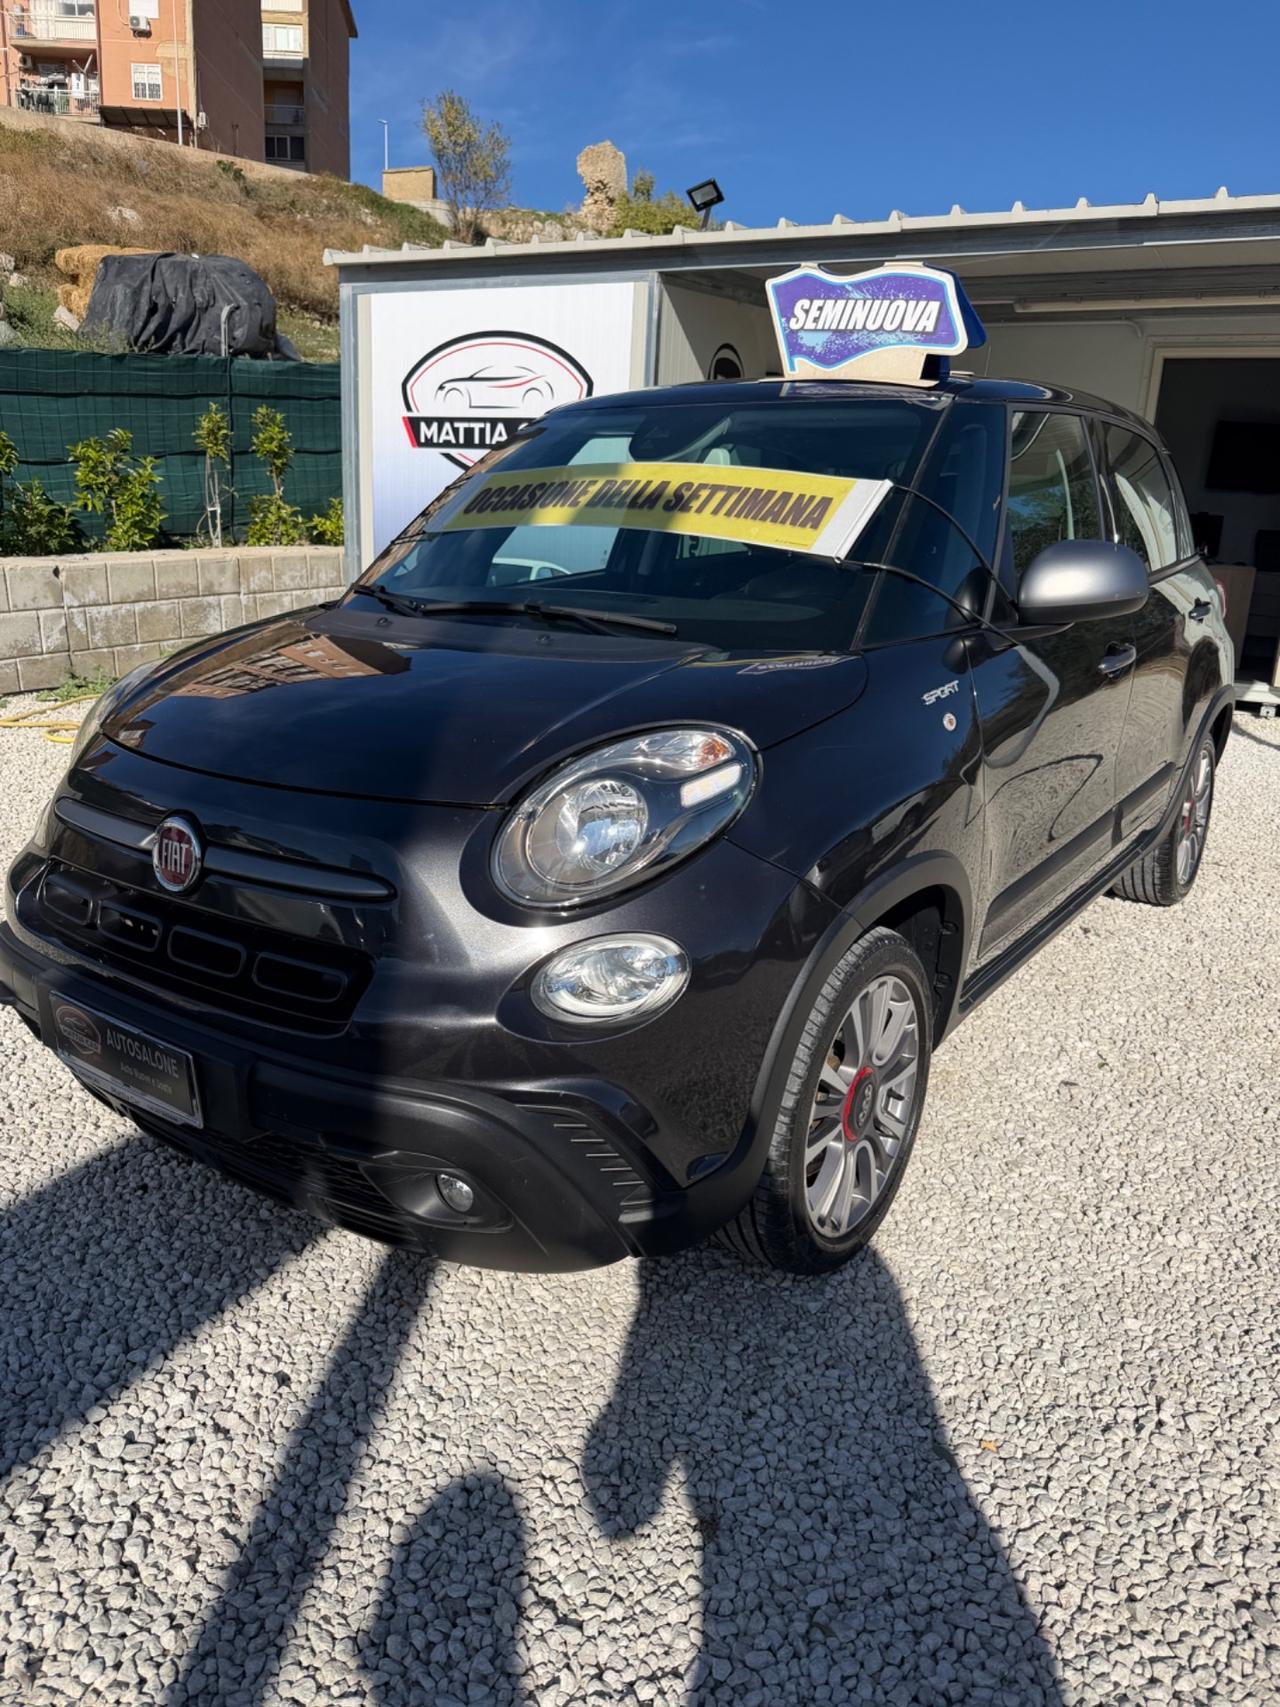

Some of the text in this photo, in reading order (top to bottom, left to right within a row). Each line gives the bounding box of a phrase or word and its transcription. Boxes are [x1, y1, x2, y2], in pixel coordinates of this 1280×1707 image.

[789, 298, 941, 333] SEMINUOVA
[420, 421, 508, 445] MATTIA
[463, 479, 834, 530] OCCASIONE DELLA SETTIMANA
[921, 680, 959, 705] SPORT
[161, 838, 190, 875] FIAT
[106, 1028, 179, 1078] AUTOSALONE
